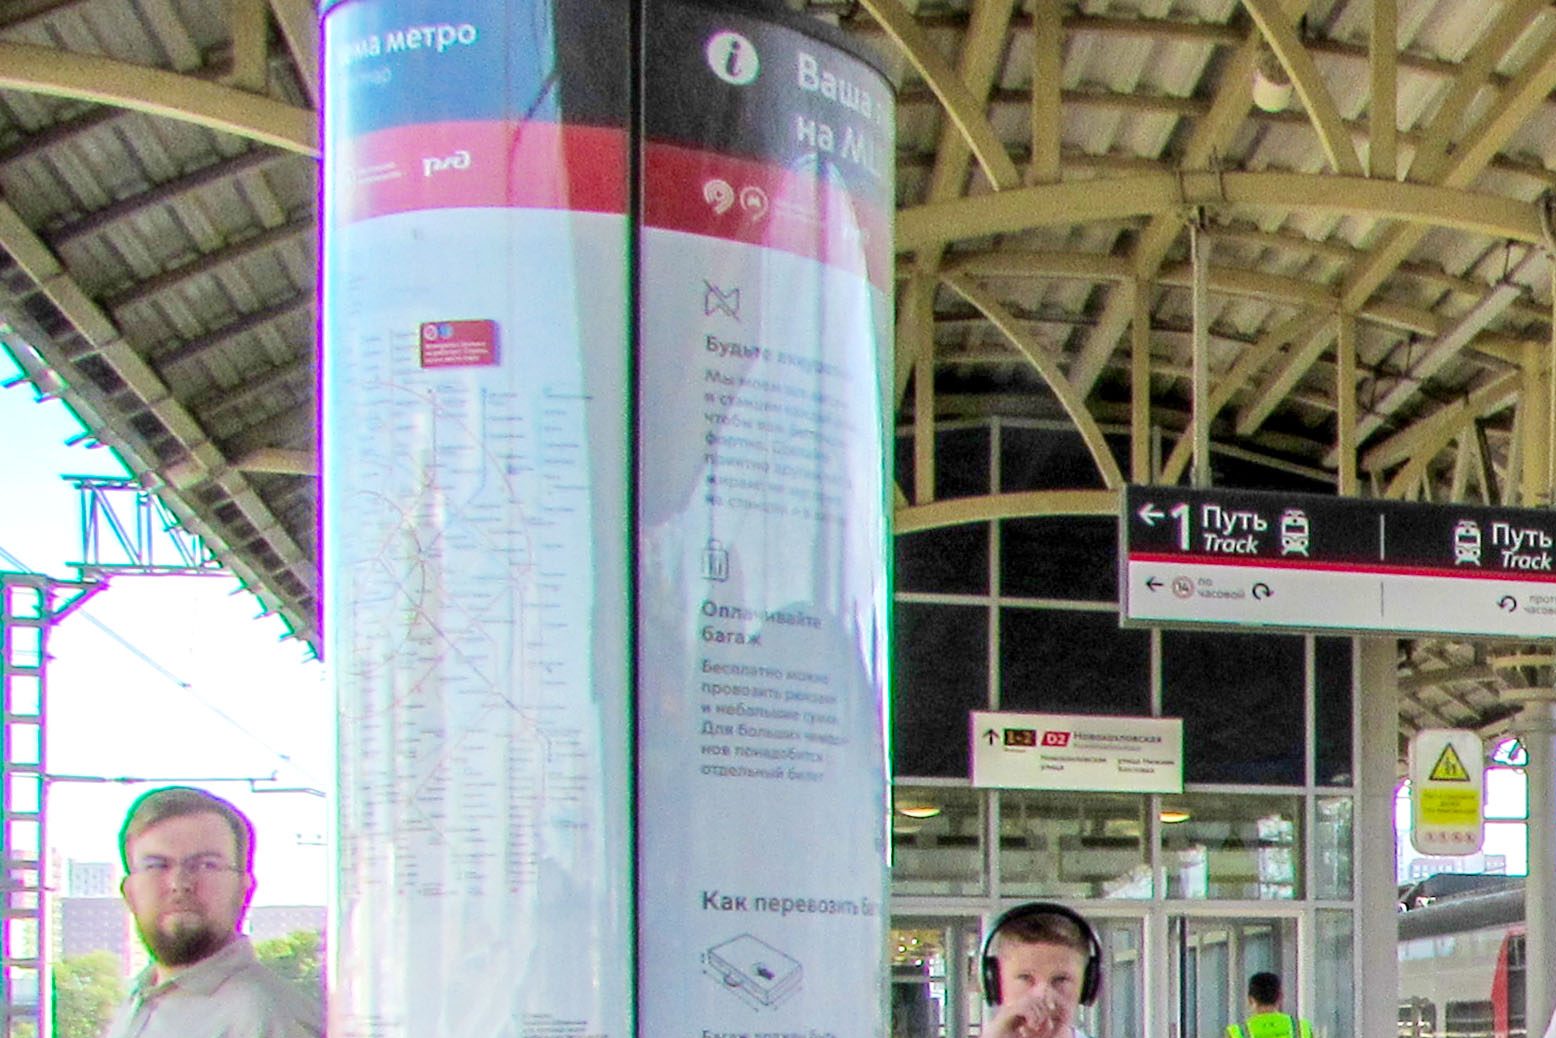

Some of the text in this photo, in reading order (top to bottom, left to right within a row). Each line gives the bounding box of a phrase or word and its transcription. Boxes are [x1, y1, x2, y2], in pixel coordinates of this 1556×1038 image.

[386, 23, 479, 53] метро
[797, 115, 836, 153] на
[1172, 503, 1191, 551] 1
[1202, 505, 1268, 536] Путь
[1203, 533, 1258, 554] Track
[1492, 523, 1552, 551] Путь
[1502, 551, 1551, 571] Track
[702, 600, 822, 629] Опливайте
[702, 625, 762, 645] багаж
[702, 658, 784, 681] Бесплатно
[701, 719, 734, 736] Для
[702, 890, 748, 911] Как
[754, 896, 859, 917] перевозить
